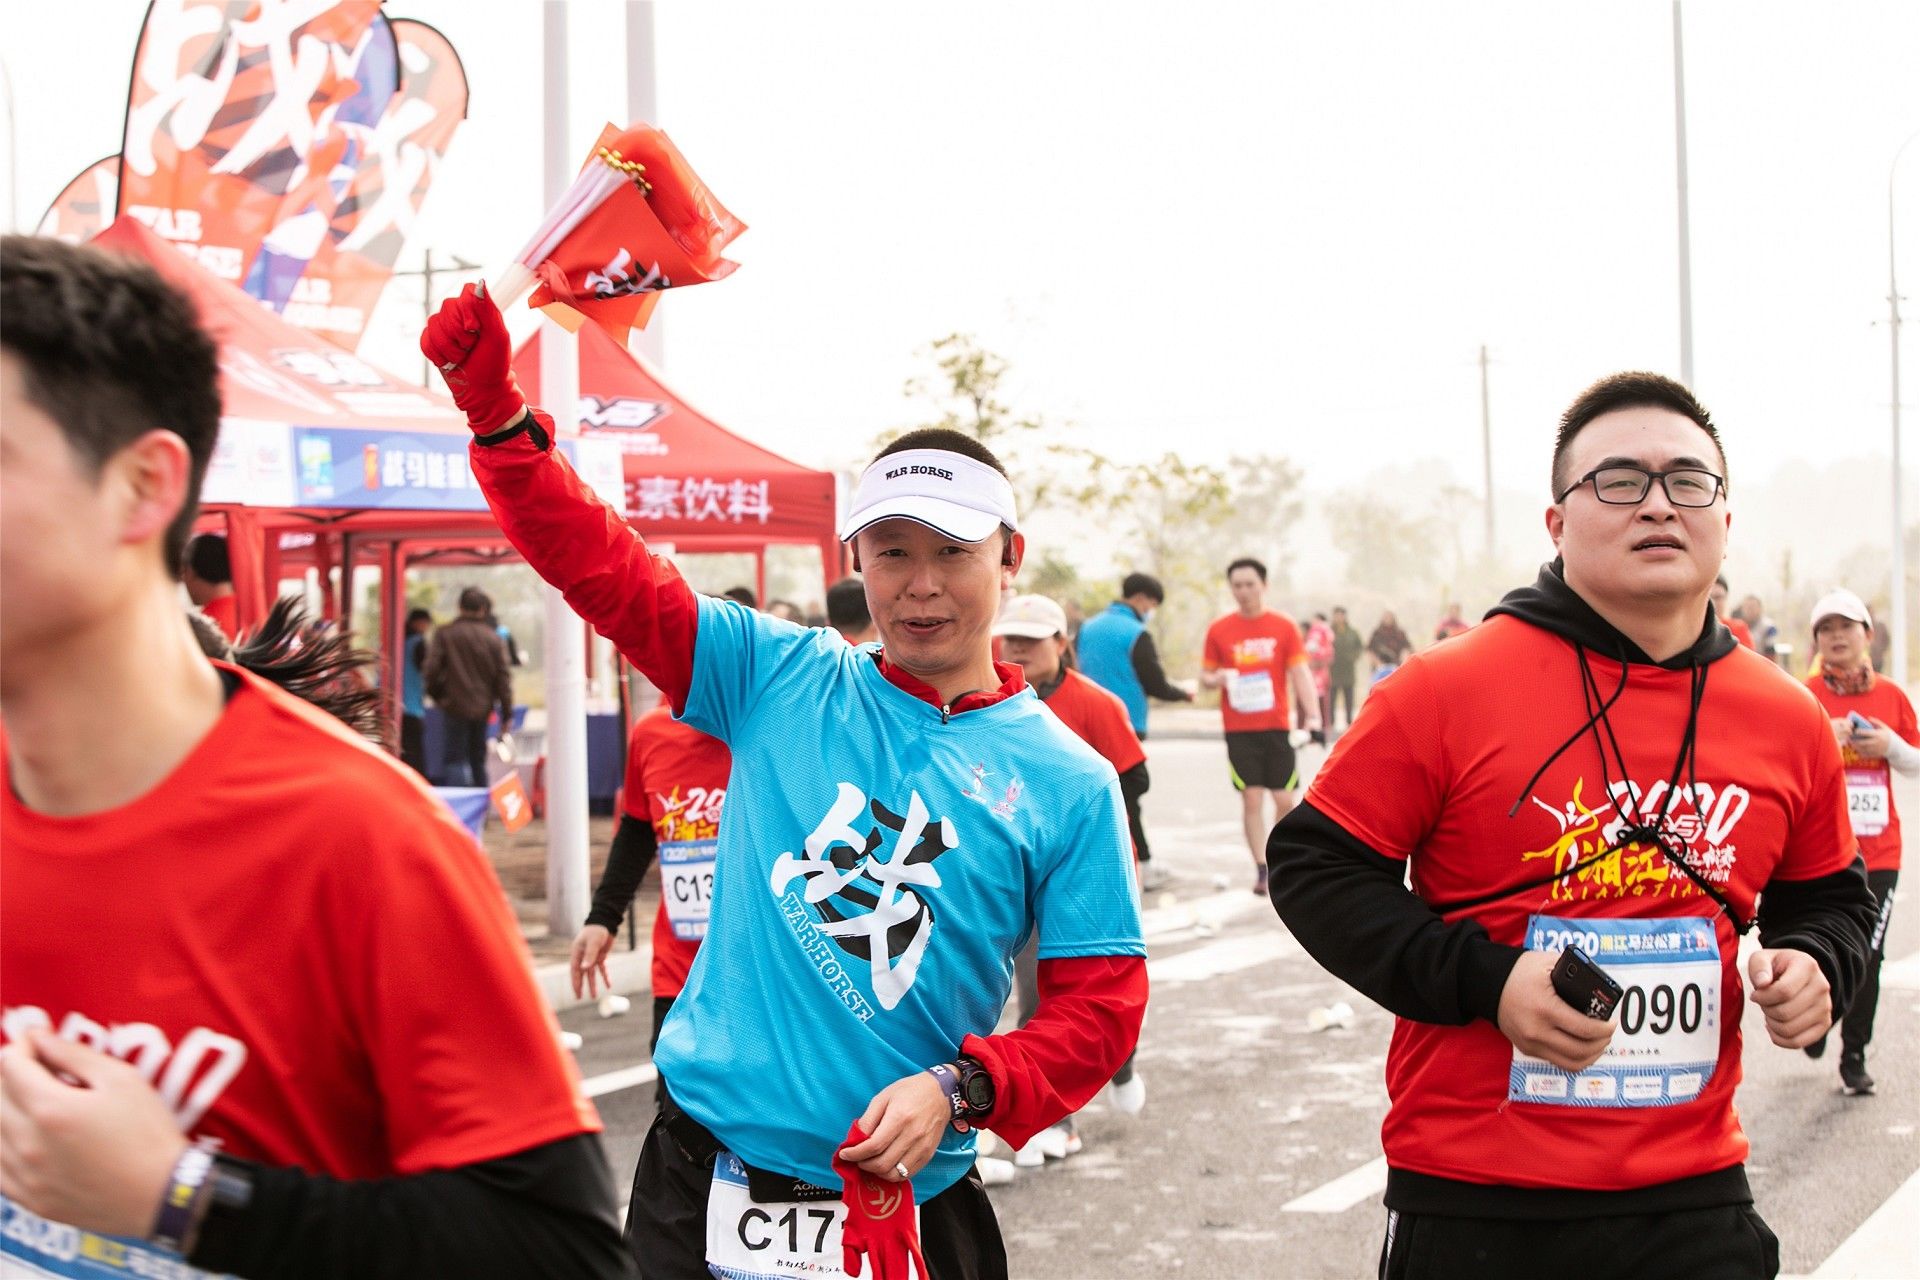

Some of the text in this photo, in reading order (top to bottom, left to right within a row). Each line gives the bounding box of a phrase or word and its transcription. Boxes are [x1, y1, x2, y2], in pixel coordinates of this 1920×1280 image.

[885, 465, 953, 481] WAR HORSE
[1577, 836, 1669, 888] 湘江
[1619, 983, 1702, 1036] 090
[737, 1207, 848, 1254] C17
